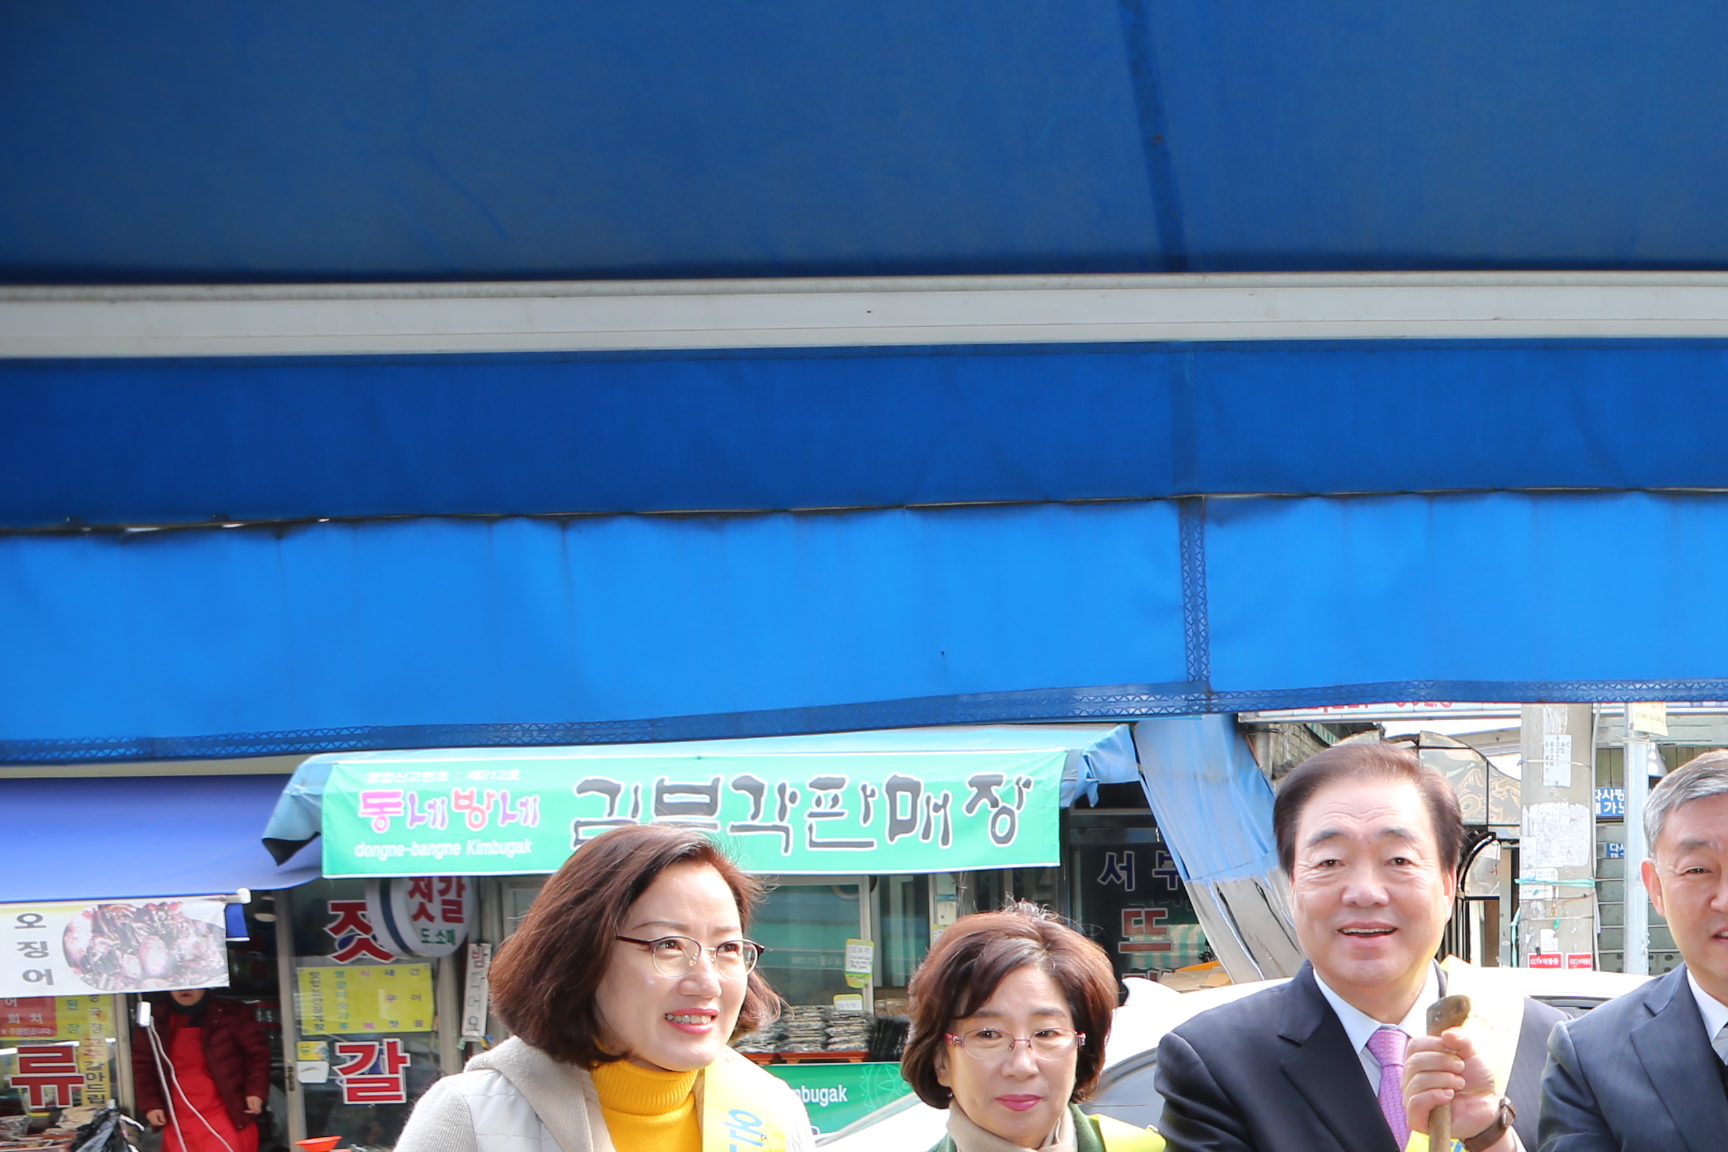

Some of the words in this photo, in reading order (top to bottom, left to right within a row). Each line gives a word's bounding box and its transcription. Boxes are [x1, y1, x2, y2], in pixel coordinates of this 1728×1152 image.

[358, 786, 541, 834] 동네방네
[465, 838, 534, 859] Kimbugak
[14, 912, 55, 986] 오징어
[10, 1045, 86, 1109] 류
